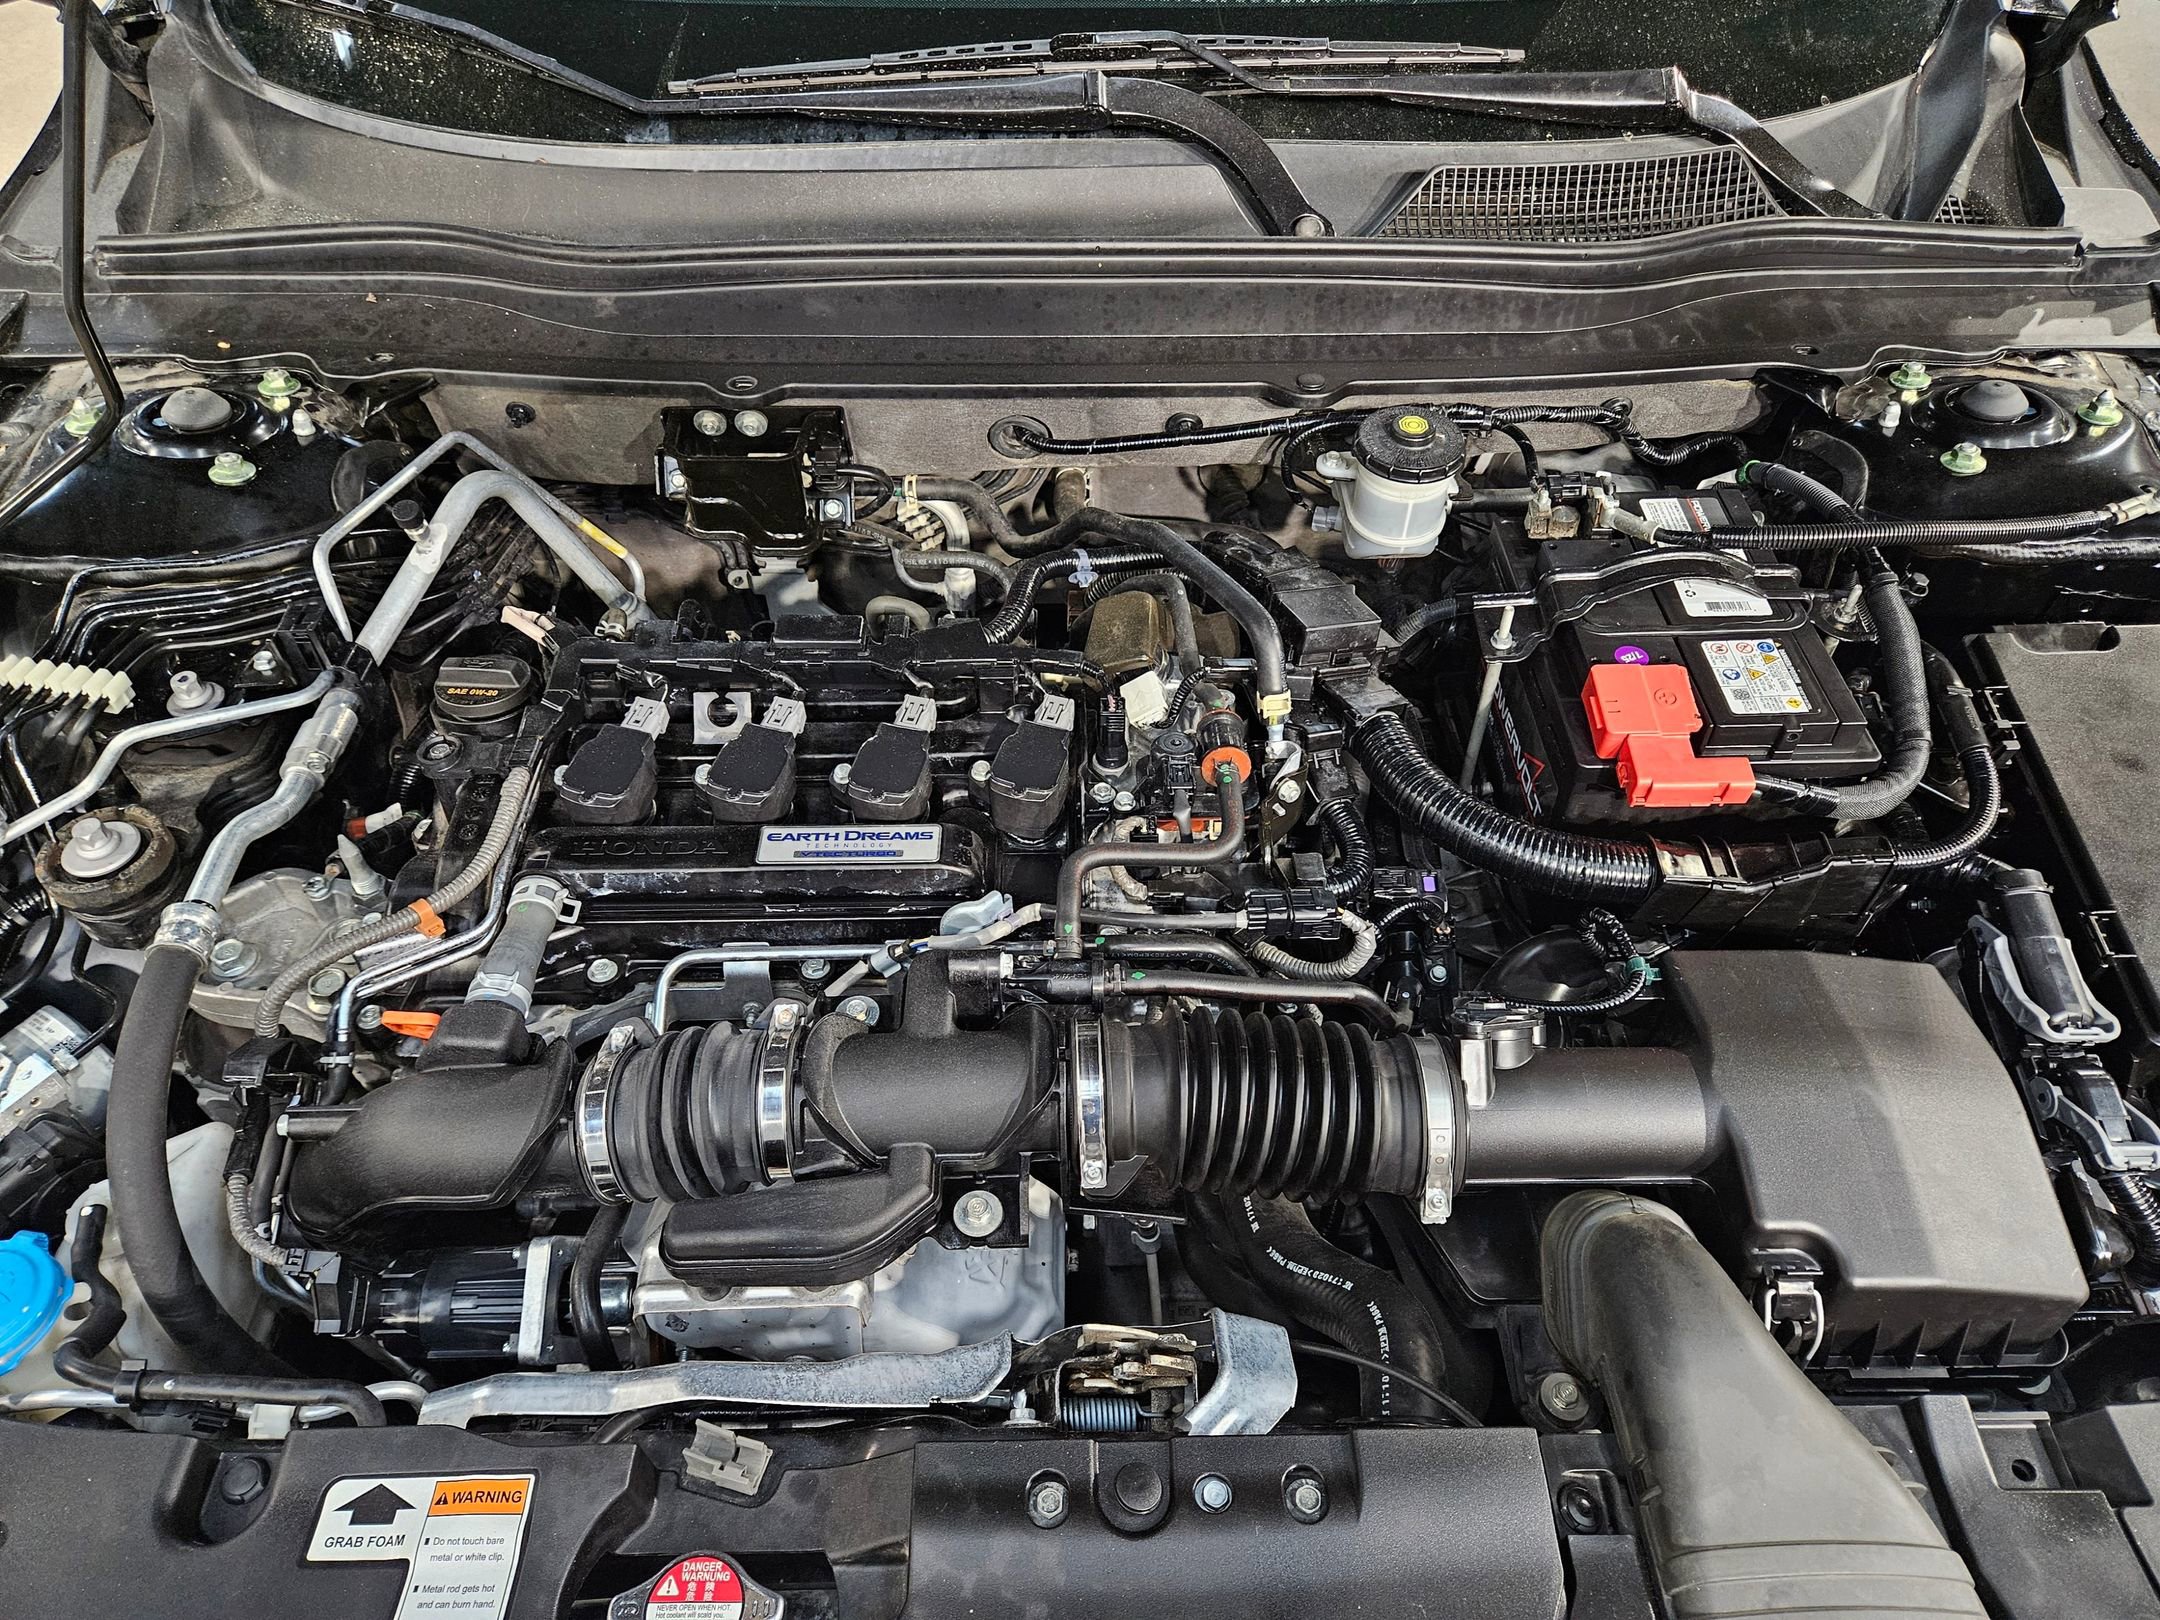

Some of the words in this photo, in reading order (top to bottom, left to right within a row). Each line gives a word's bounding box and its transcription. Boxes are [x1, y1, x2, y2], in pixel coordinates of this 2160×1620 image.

[446, 687, 468, 695] SAE
[469, 688, 499, 697] 0W-20
[1494, 679, 1543, 818] OWERVOLT
[766, 832, 840, 842] EARTH
[844, 830, 934, 841] DREAMS
[570, 839, 729, 856] HONDA
[452, 1491, 522, 1504] WARNING
[324, 1536, 364, 1548] GRAB
[367, 1535, 406, 1548] FOAM
[433, 1537, 446, 1545] Do
[448, 1537, 461, 1545] not
[462, 1537, 484, 1545] touch
[486, 1537, 505, 1545] bare
[430, 1553, 454, 1562] metal
[465, 1553, 486, 1561] white
[487, 1553, 505, 1563] clip.
[683, 1562, 722, 1572] DANGER
[682, 1572, 731, 1581] WARNUNG
[422, 1584, 445, 1593] Metal
[447, 1584, 461, 1593] rod
[462, 1586, 480, 1595] gets
[481, 1584, 495, 1592] hot
[417, 1600, 433, 1609] and
[452, 1600, 471, 1608] burn
[473, 1600, 496, 1608] hand.
